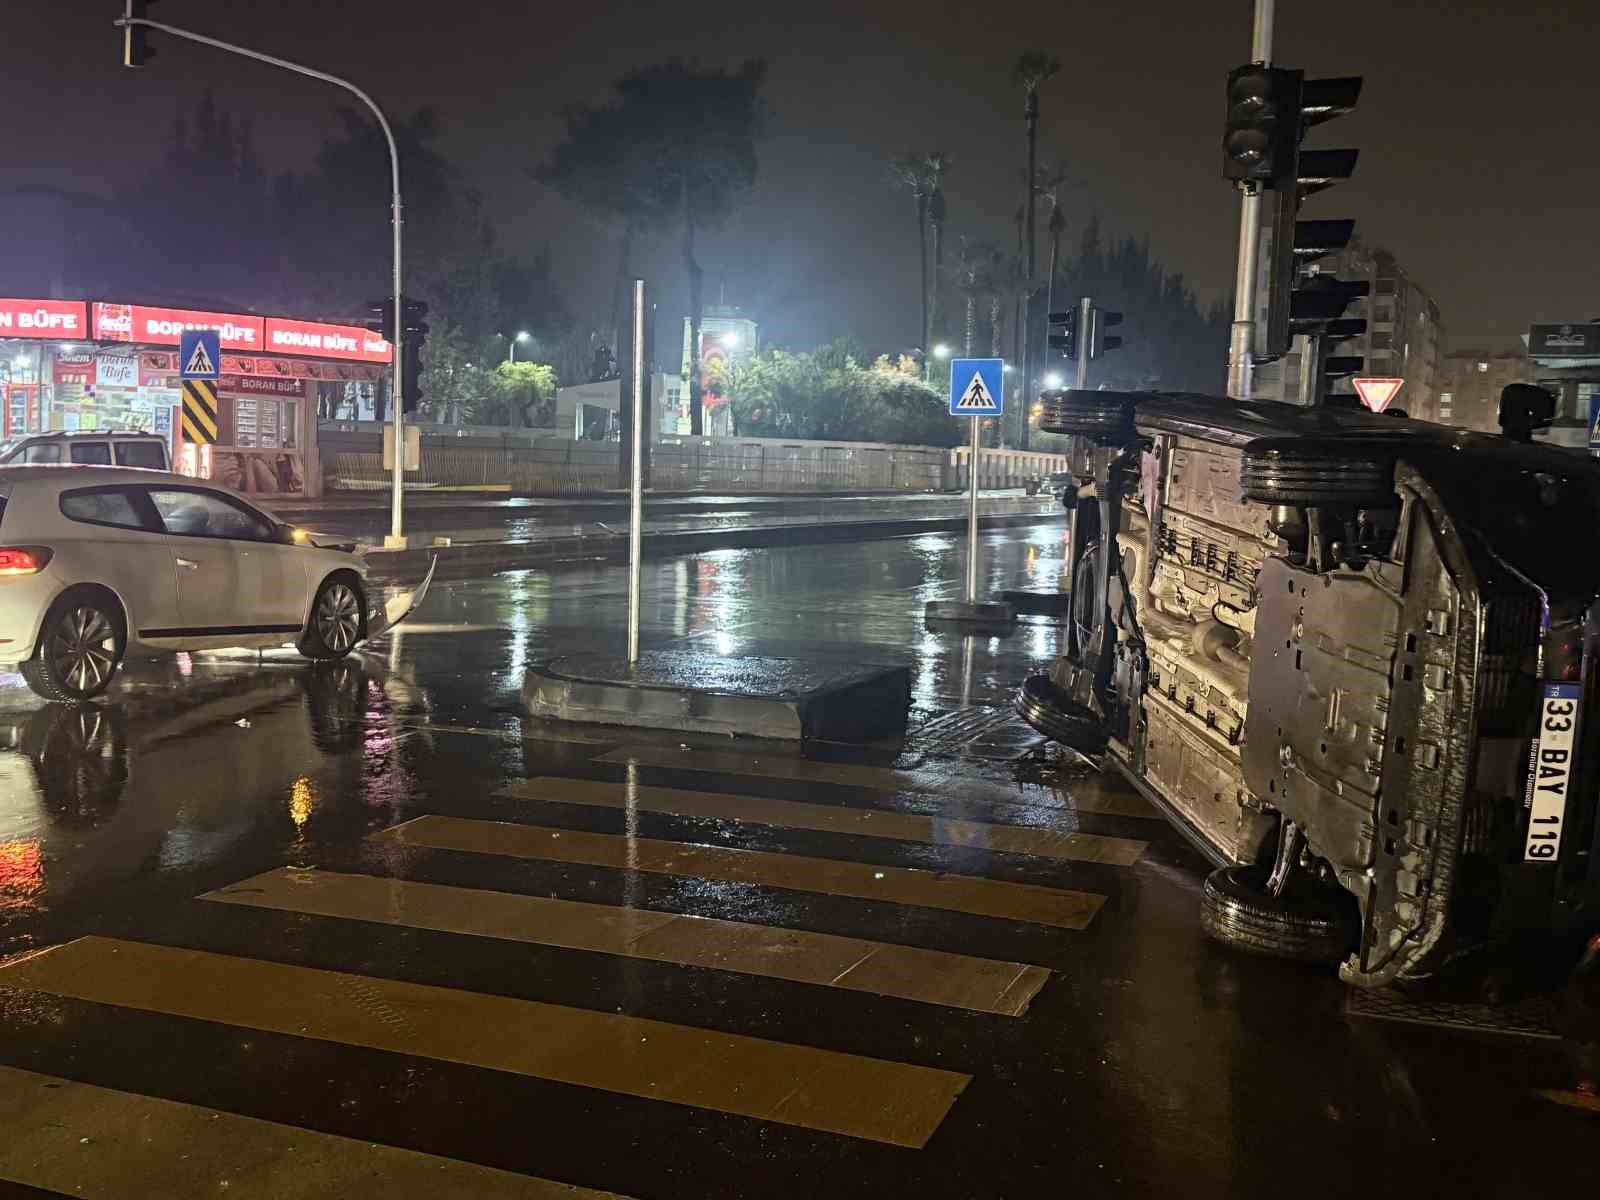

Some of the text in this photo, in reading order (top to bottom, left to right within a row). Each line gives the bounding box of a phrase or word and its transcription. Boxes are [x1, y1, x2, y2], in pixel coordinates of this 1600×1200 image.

[18, 309, 78, 329] BÜFE
[147, 319, 209, 335] BOR
[272, 330, 321, 348] BORAN
[323, 333, 357, 352] BÜFE
[242, 378, 275, 390] BORAN
[1551, 686, 1560, 697] TR
[1528, 700, 1574, 858] 33 BAY 119
